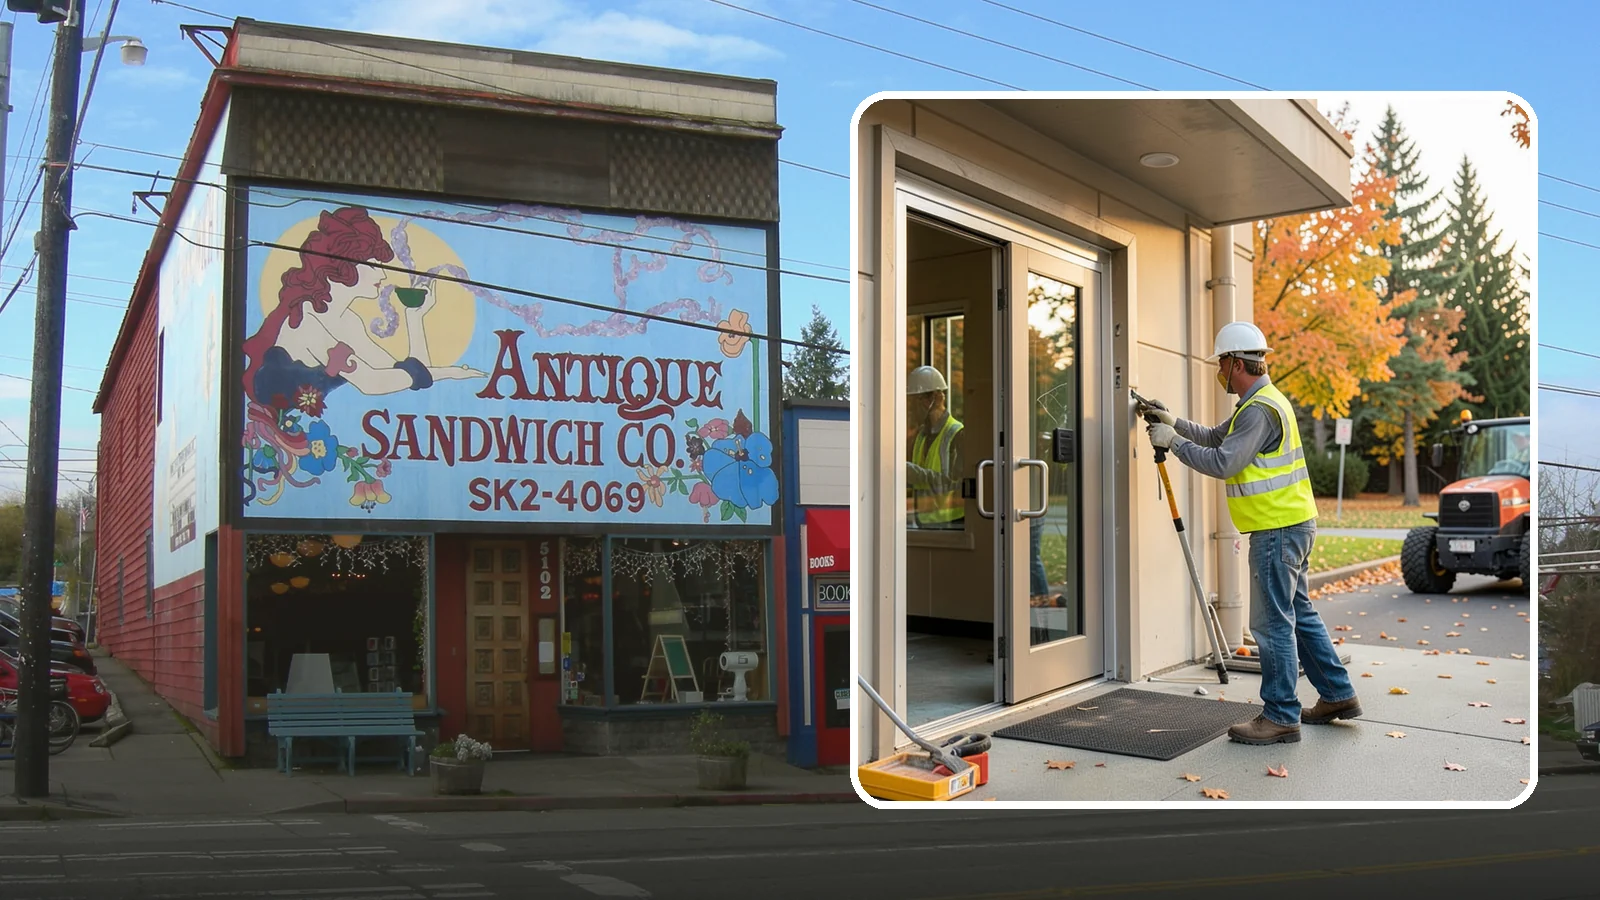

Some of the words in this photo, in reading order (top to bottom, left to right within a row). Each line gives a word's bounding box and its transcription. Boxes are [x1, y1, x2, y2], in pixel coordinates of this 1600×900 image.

[475, 329, 723, 420] ANTIQUE
[361, 408, 604, 467] SANDWICH
[617, 422, 685, 468] CO.
[468, 477, 645, 513] SK2-4069
[540, 541, 552, 599] 5102
[809, 555, 835, 569] BOOKS
